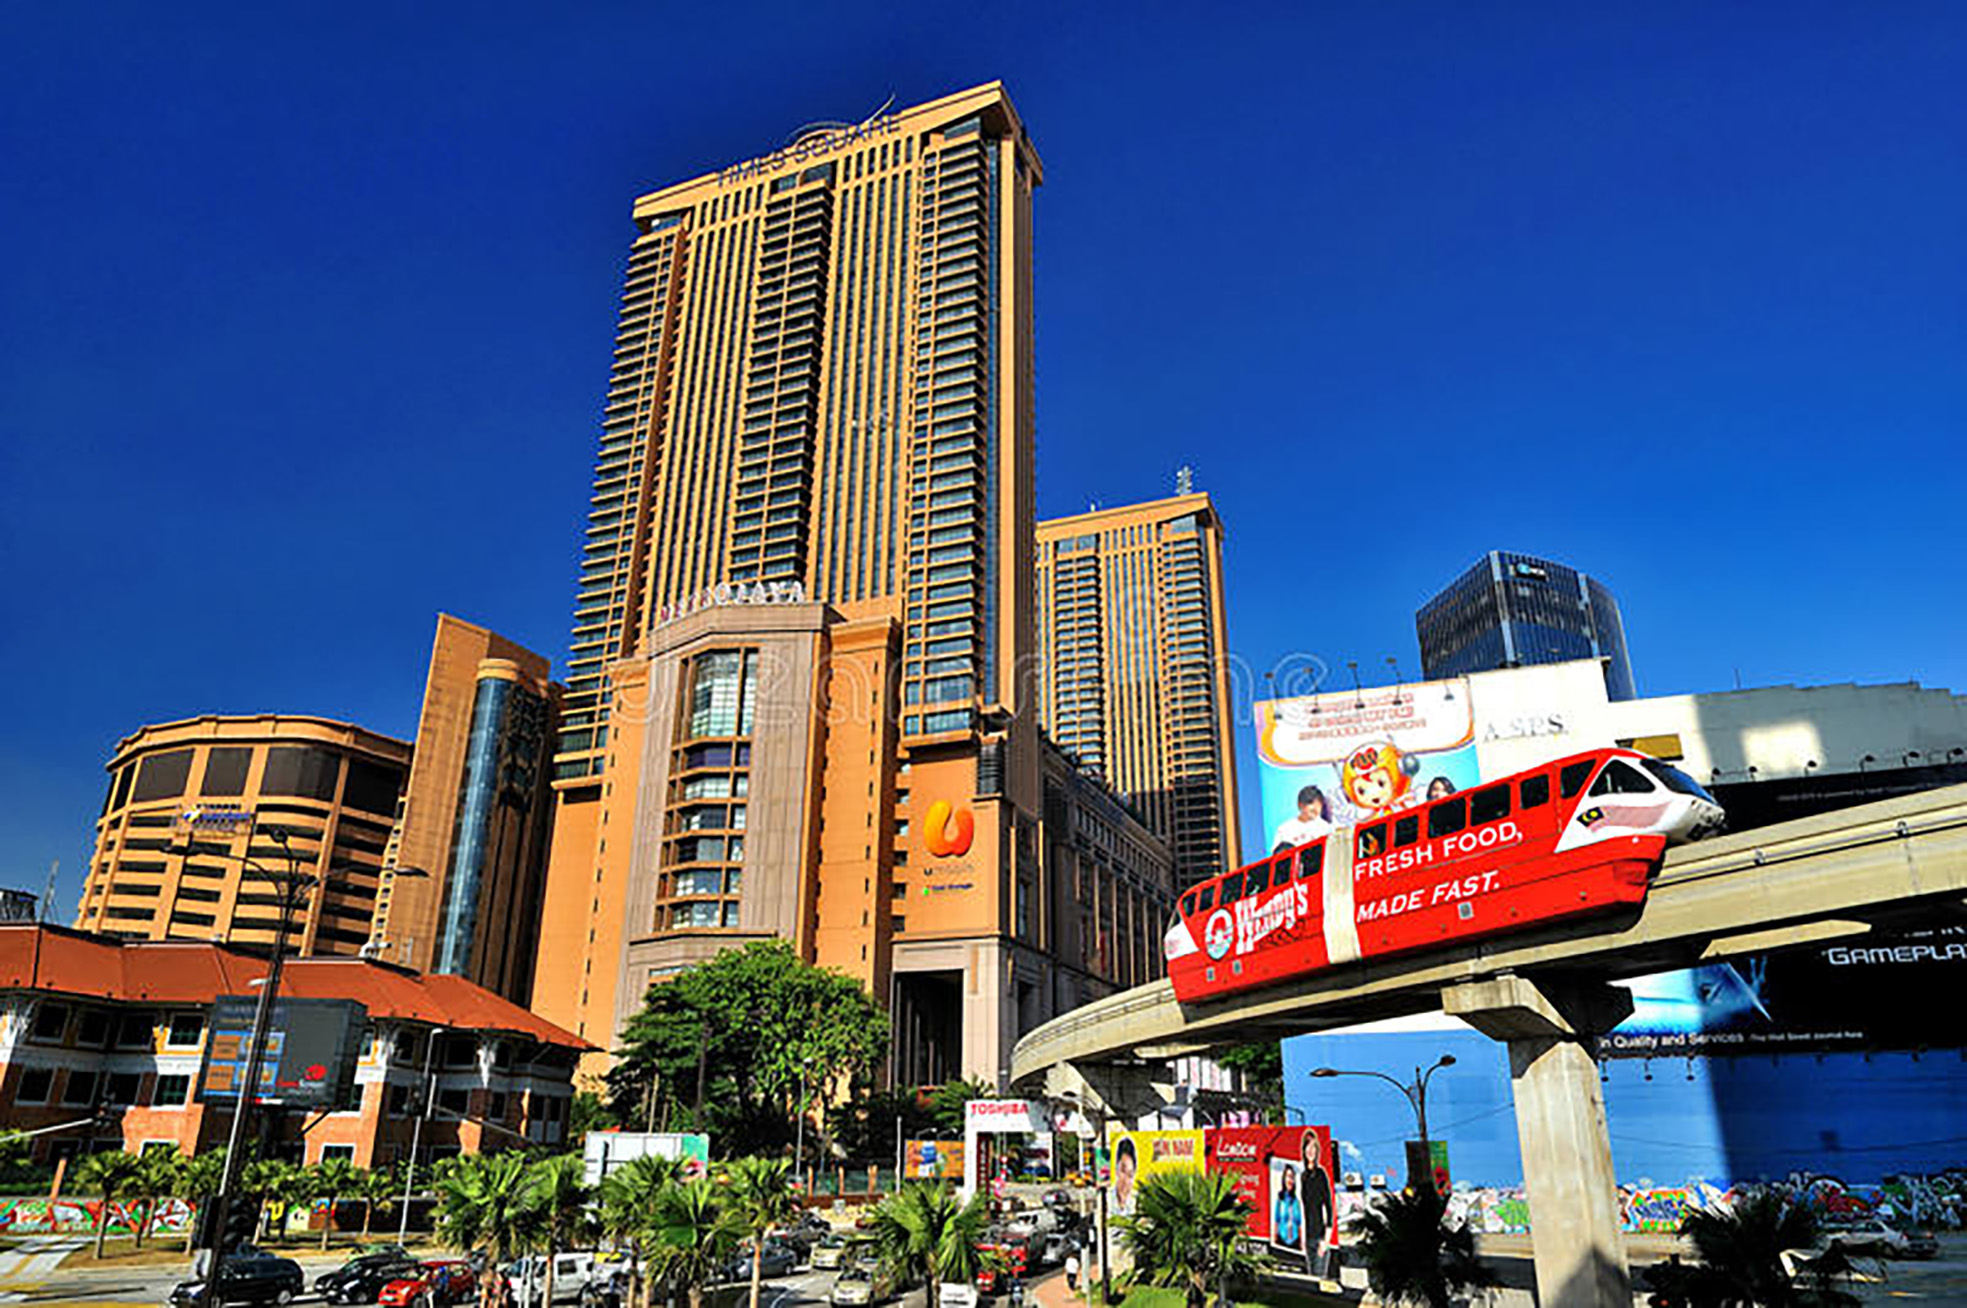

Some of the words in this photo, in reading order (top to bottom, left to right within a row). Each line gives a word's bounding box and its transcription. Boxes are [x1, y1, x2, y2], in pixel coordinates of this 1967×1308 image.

[794, 114, 901, 164] SQUARE
[1354, 843, 1433, 882] FRESH
[1443, 821, 1523, 857] FOOD,
[1356, 889, 1425, 924] MADE
[1430, 870, 1500, 905] FAST.
[1827, 943, 1967, 965] GAMEPLA
[1613, 1035, 1658, 1051] Quality
[1661, 1033, 1686, 1047] and
[1688, 1031, 1744, 1046] Services
[970, 1103, 1029, 1116] TOSHIBA
